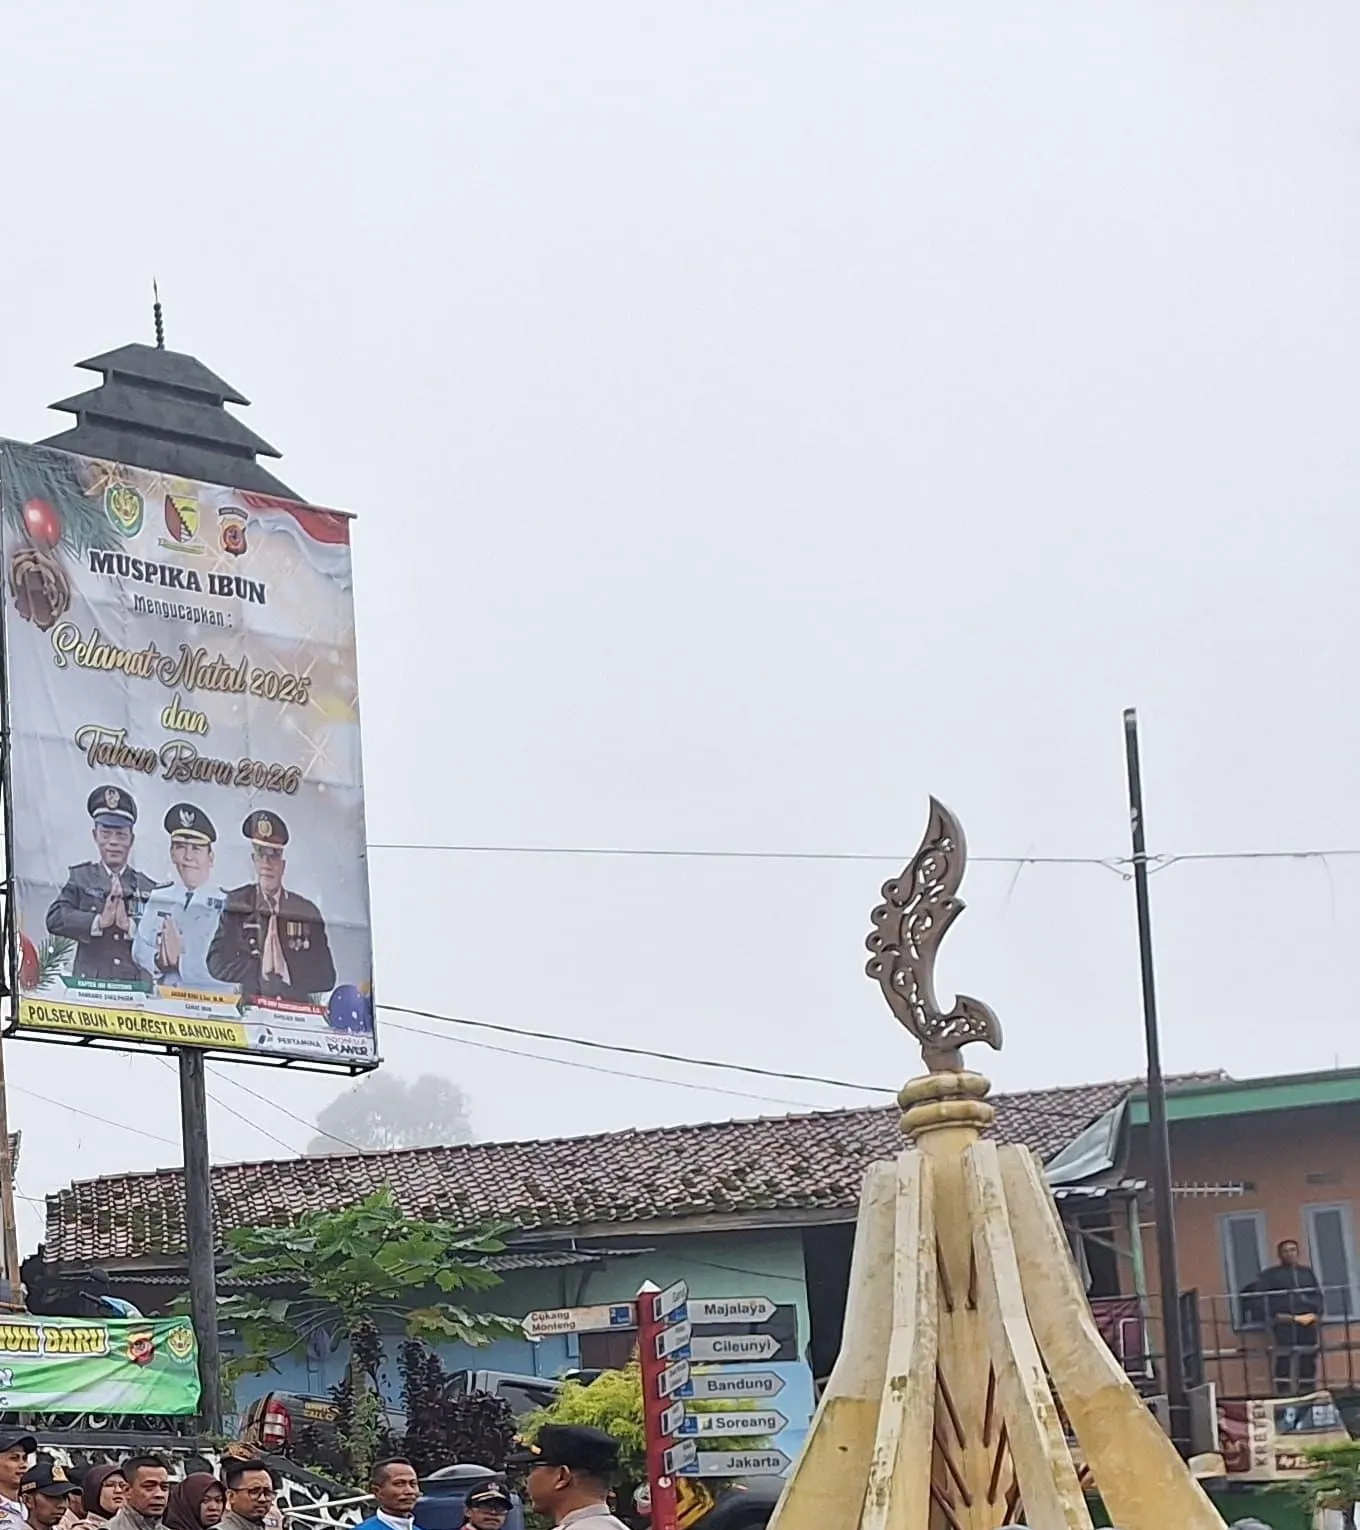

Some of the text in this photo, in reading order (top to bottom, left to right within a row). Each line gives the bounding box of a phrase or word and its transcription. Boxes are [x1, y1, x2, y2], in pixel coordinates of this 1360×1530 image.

[89, 551, 266, 604] MUSPIKA IBUN
[51, 621, 312, 704] Selamat Natal 2025
[160, 692, 209, 735] dan
[75, 724, 301, 794] Tahun Baru 2026
[28, 1006, 76, 1025] POLSEK
[79, 1011, 108, 1029] IBUN
[118, 1018, 177, 1037] POLRESTA
[180, 1023, 236, 1042] BANDUNG
[531, 1311, 571, 1322] Cukang
[704, 1302, 767, 1318] Majalaya
[43, 1326, 107, 1354] BARU
[712, 1339, 772, 1356] Cileunyi
[707, 1377, 773, 1395] Bandung
[716, 1415, 776, 1430] Soreang
[727, 1455, 780, 1469] Jakarta
